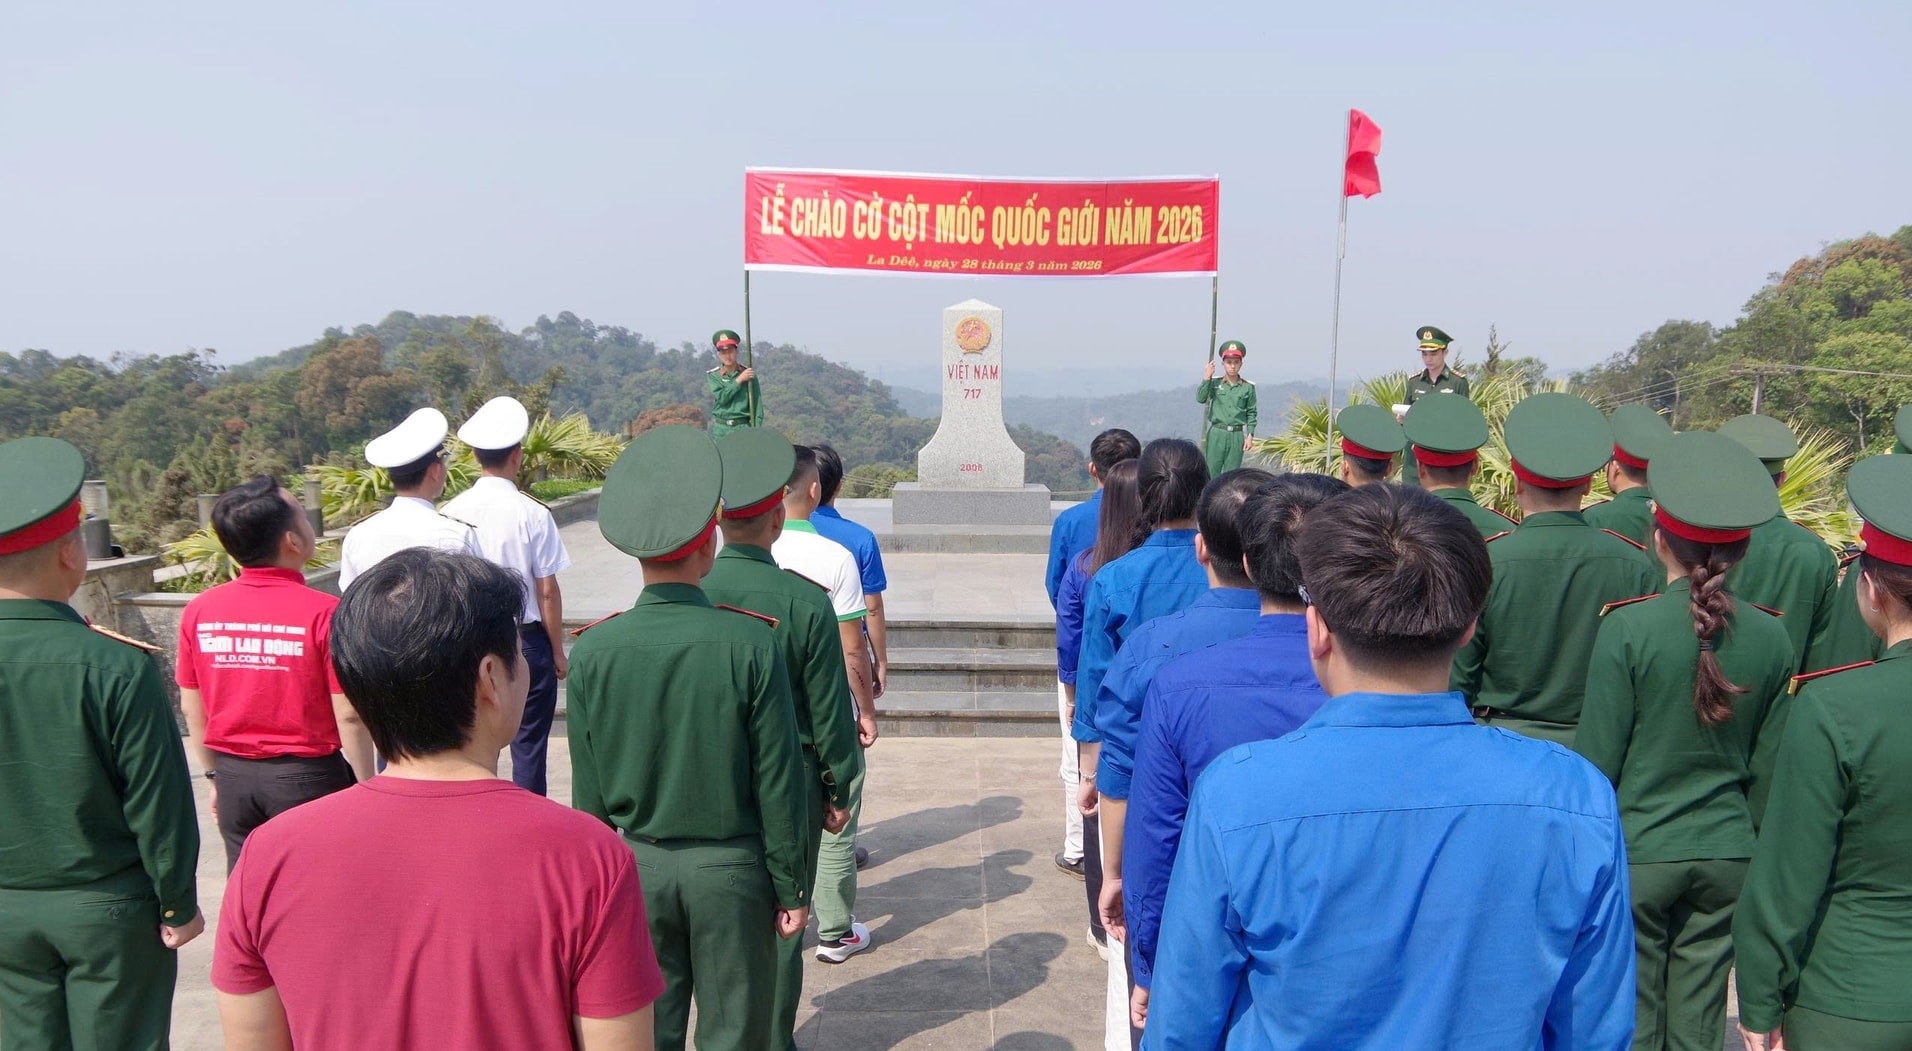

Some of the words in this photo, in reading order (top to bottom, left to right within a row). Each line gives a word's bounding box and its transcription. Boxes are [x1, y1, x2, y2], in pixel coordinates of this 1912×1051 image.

[761, 183, 785, 236] LỄ
[790, 190, 847, 239] CHÀO
[853, 191, 883, 241] CỜ
[888, 194, 930, 250] CỘT
[935, 191, 985, 245] MỐC
[992, 193, 1051, 249] QUỐC
[1057, 199, 1100, 246] GIỚI
[1105, 198, 1152, 246] NĂM
[1156, 205, 1203, 244] 2026
[867, 255, 886, 265] La
[888, 255, 919, 268] Dêê,
[924, 257, 957, 270] ngày
[961, 259, 978, 269] 28
[981, 259, 1023, 272] tháng
[1025, 260, 1034, 270] 3
[1039, 260, 1068, 271] năm
[1071, 260, 1103, 270] 2026
[947, 360, 969, 384] VIỆT
[973, 364, 999, 380] NAM
[963, 388, 982, 399] 717
[960, 463, 983, 472] 2008
